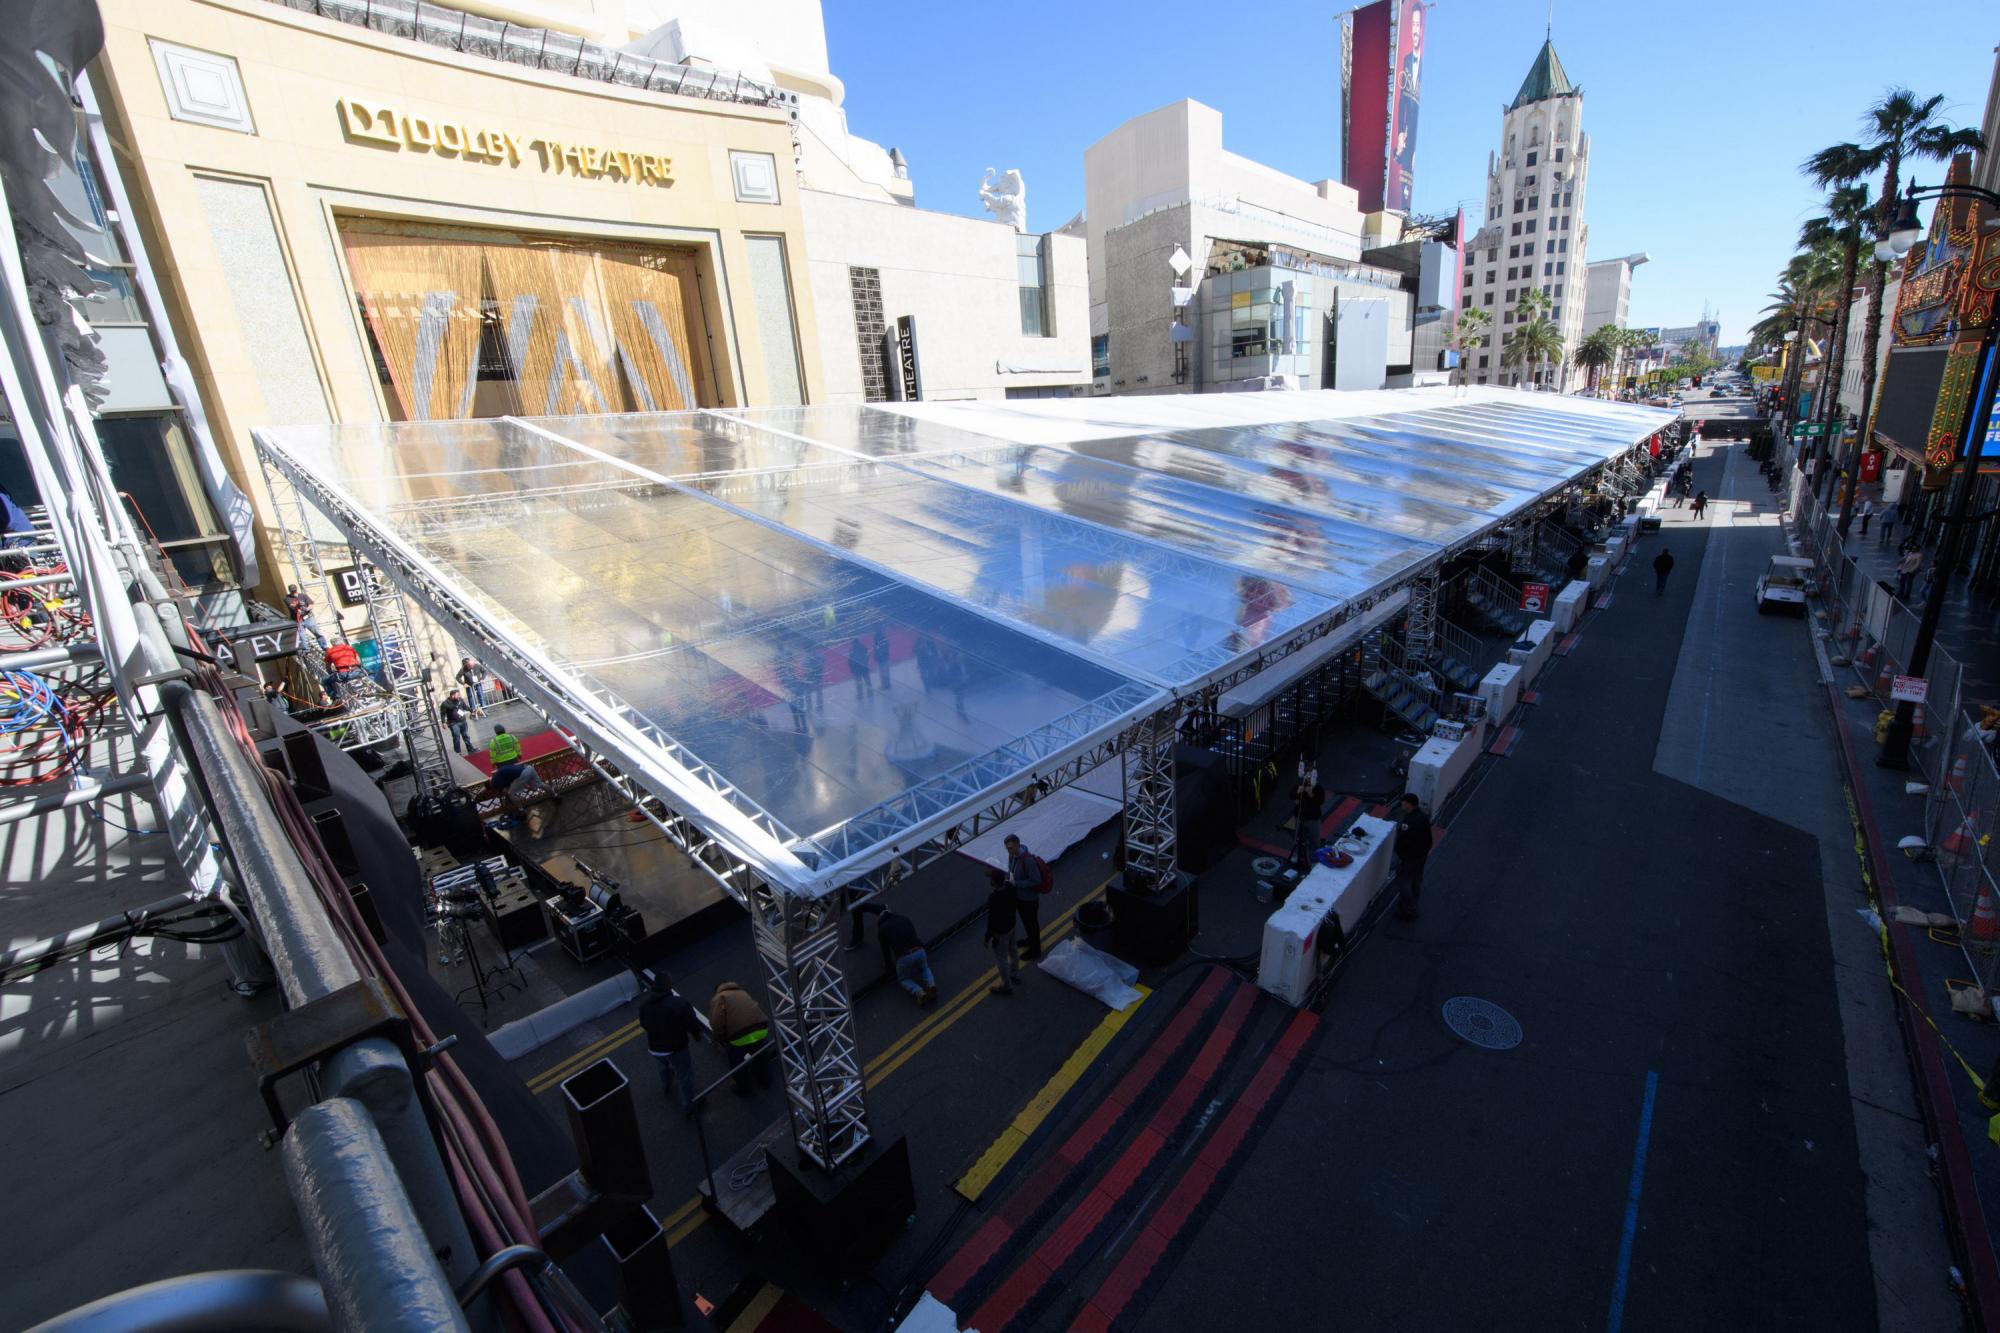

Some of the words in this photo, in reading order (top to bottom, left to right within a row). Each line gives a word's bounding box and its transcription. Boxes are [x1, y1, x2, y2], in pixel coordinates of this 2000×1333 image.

[403, 113, 524, 167] DOLBY
[532, 136, 674, 187] THEATRE
[900, 327, 917, 402] THEATRE
[1867, 454, 1875, 471] ATM
